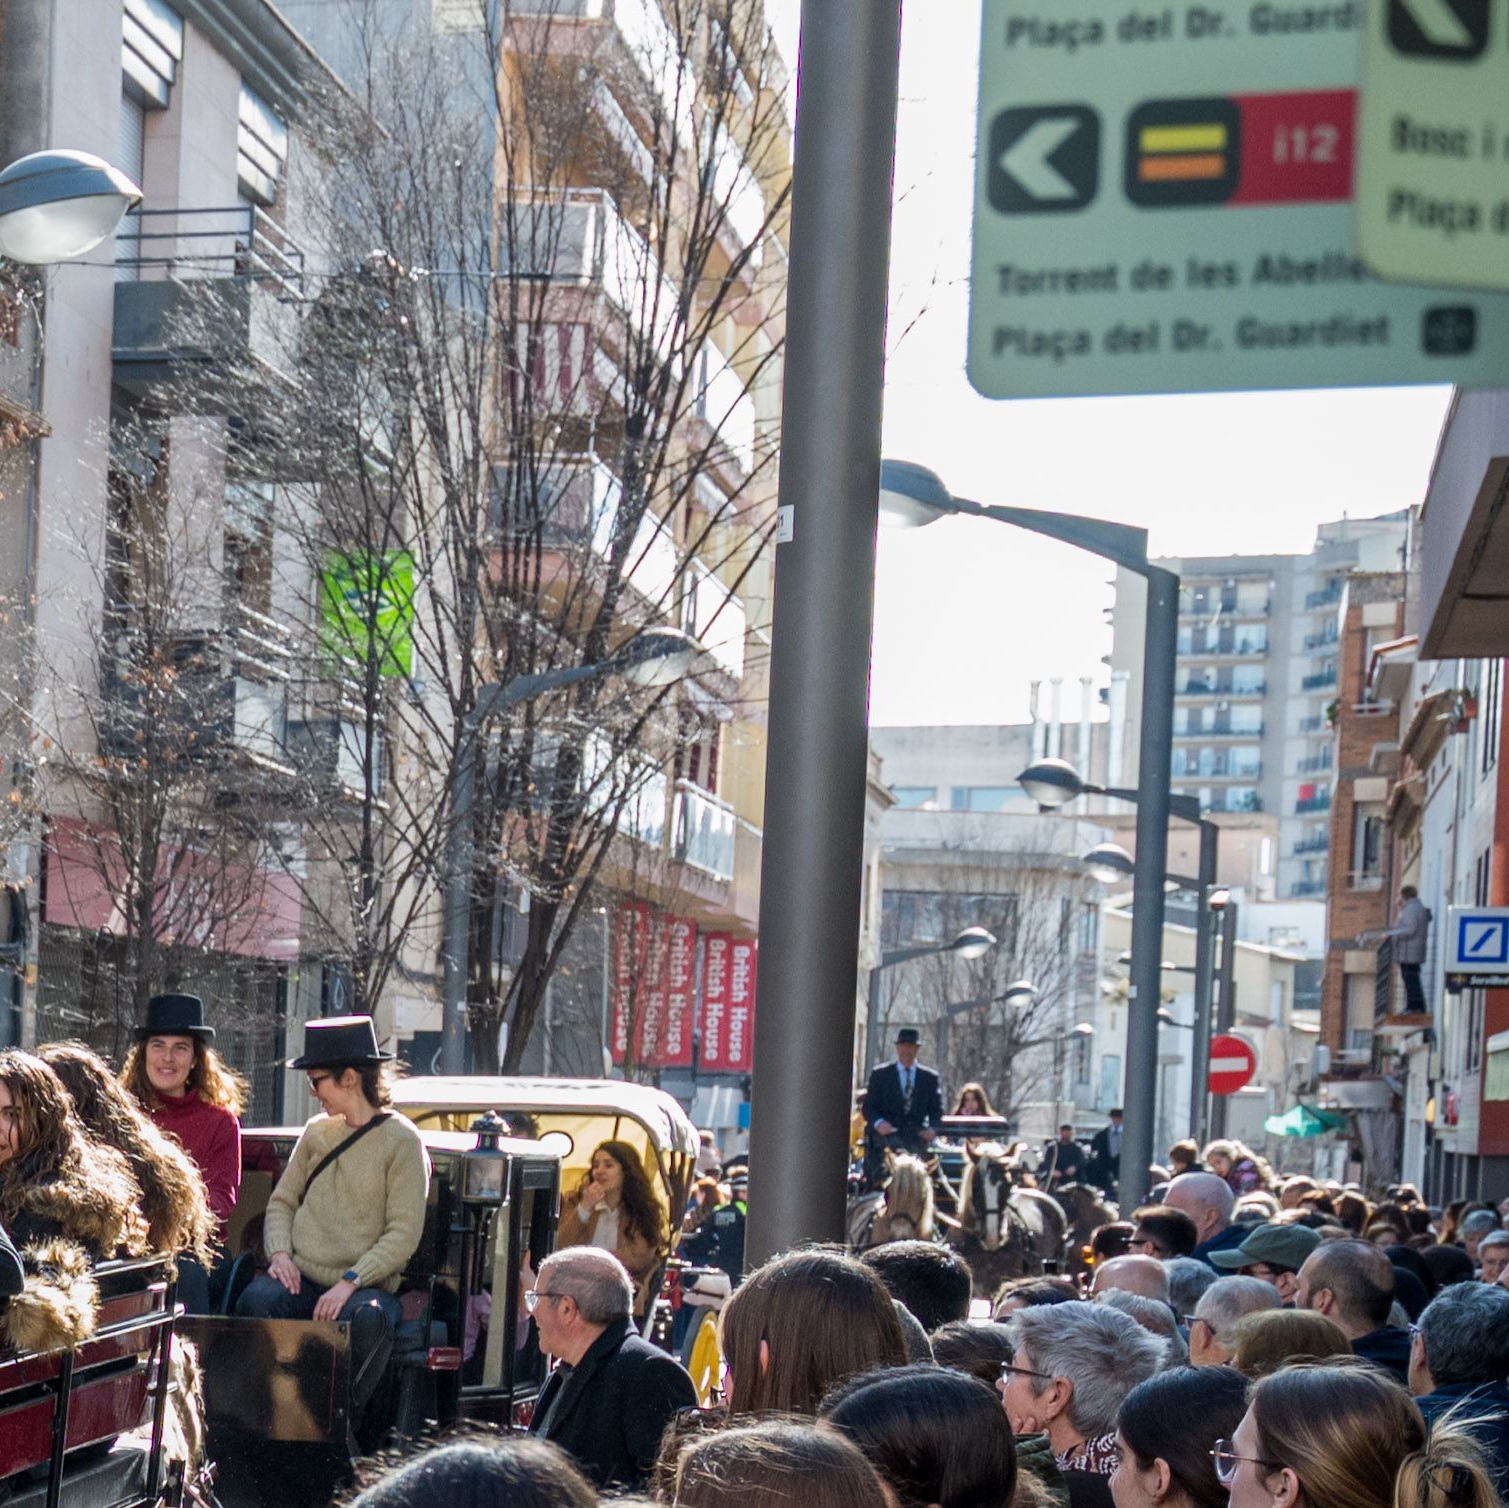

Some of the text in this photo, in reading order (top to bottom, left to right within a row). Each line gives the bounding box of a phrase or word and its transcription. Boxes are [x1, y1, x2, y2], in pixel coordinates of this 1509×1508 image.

[1005, 13, 1106, 53] Plaça
[1117, 8, 1173, 42] del
[1184, 4, 1235, 41] Dr.
[1273, 124, 1341, 164] i12
[1390, 112, 1471, 160] Bosc
[1386, 187, 1484, 239] Plaça
[996, 251, 1370, 296] Torrent de les Abelle
[991, 312, 1390, 363] Plaça del Dr. Guardiet
[666, 993, 687, 1056] House
[704, 938, 727, 1061] British House
[728, 945, 751, 1063] British House
